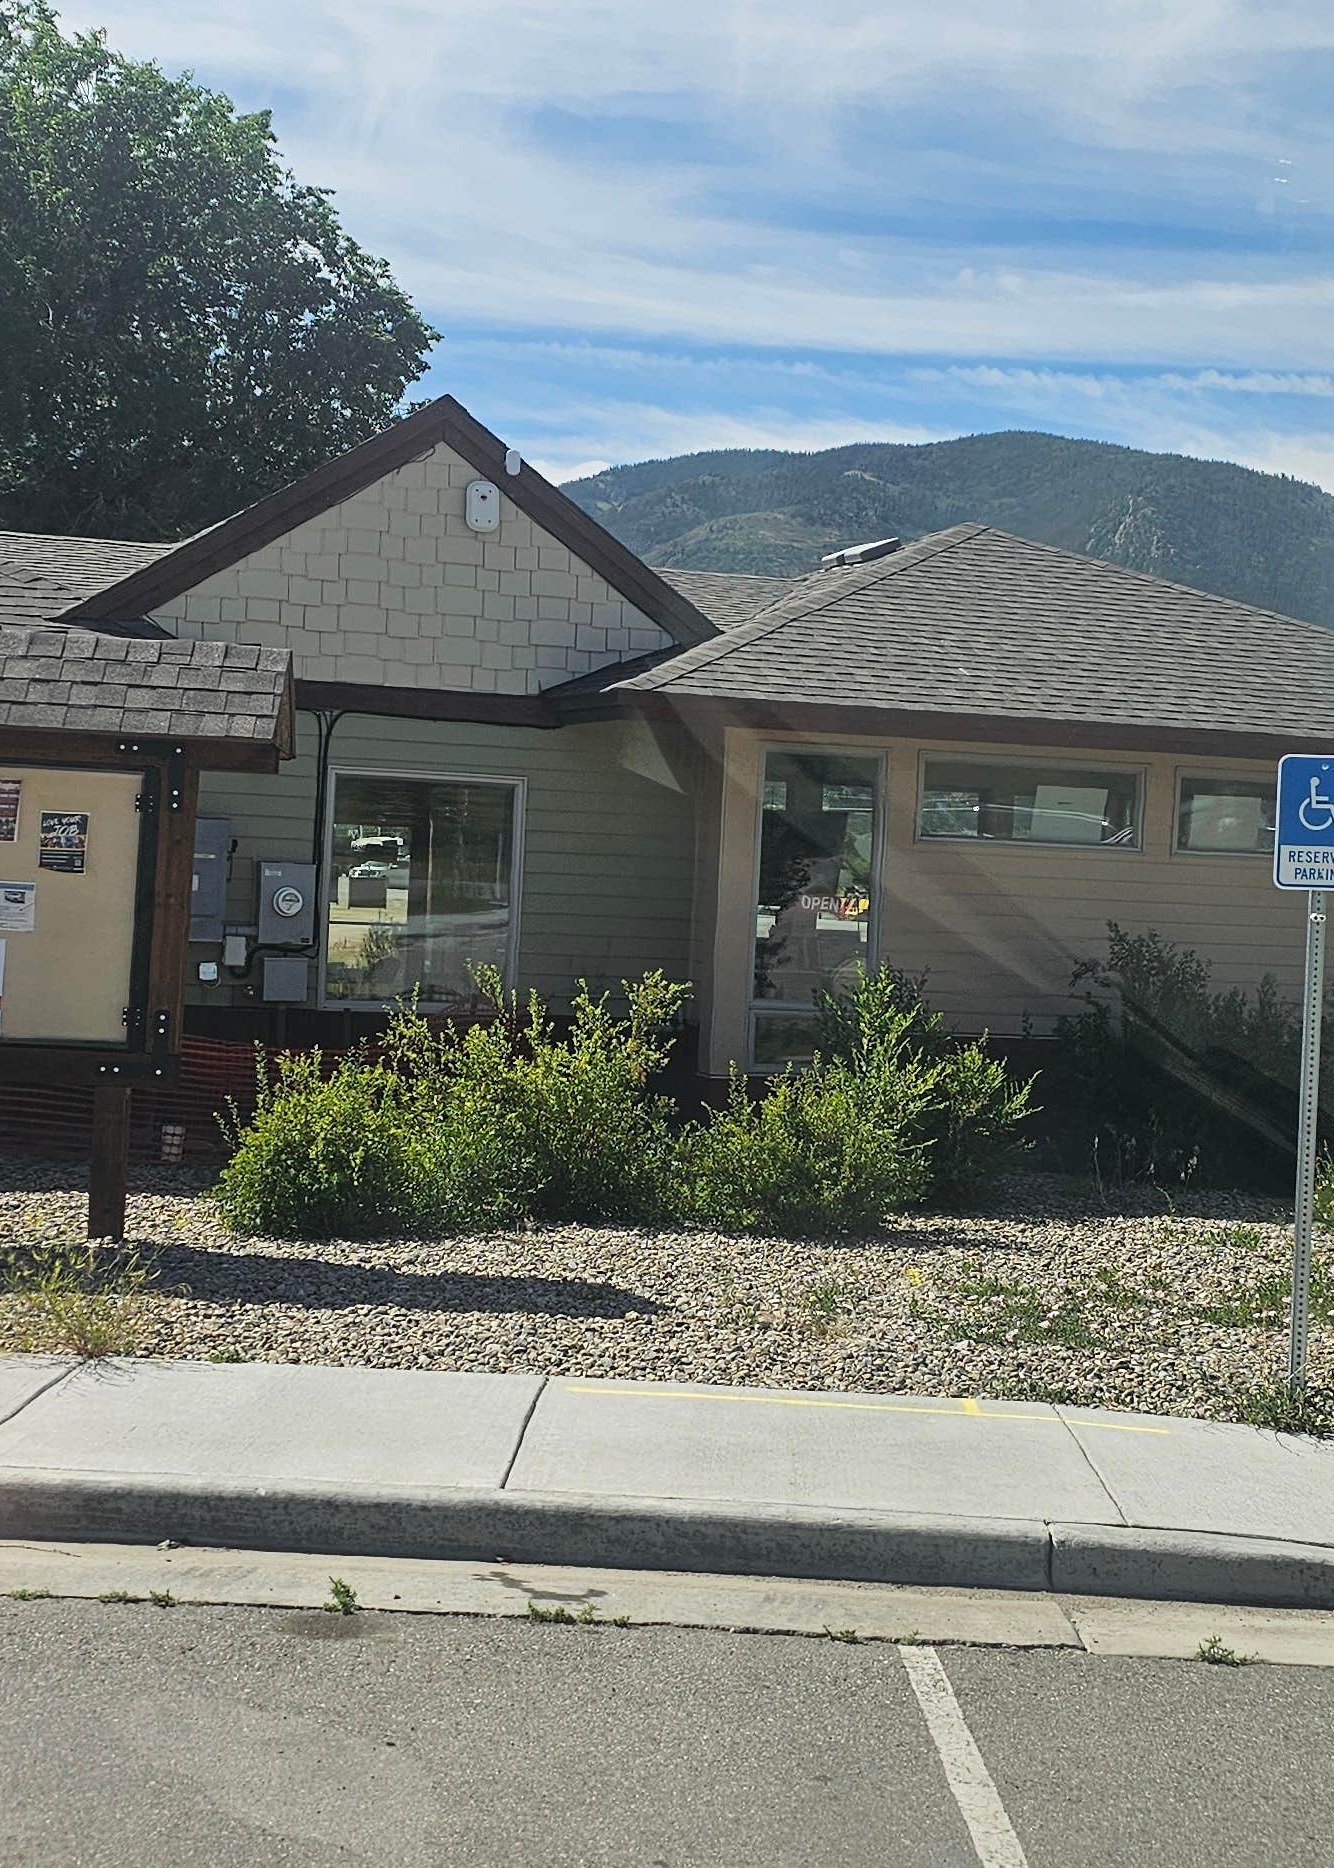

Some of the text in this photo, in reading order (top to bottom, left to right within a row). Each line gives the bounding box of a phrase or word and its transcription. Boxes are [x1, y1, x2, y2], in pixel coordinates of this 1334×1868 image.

[42, 815, 82, 827] LOVE YOUR
[49, 824, 80, 838] JOB
[802, 895, 838, 912] OPEN
